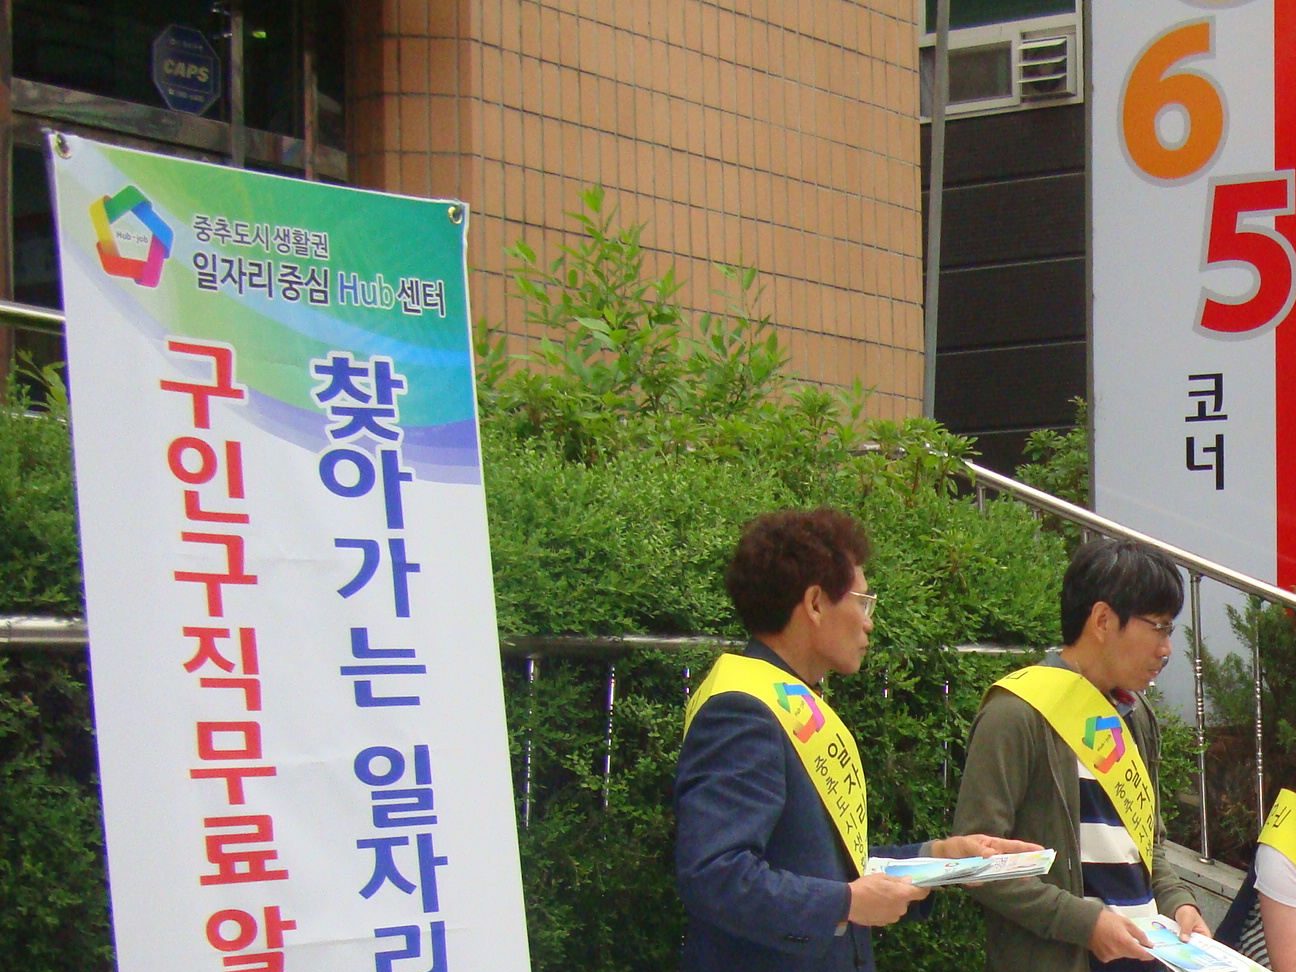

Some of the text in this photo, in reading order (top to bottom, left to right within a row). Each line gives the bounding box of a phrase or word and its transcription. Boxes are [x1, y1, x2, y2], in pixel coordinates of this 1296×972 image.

[164, 59, 209, 82] CAPS
[116, 231, 149, 244] Hub-job
[1185, 373, 1228, 490] 코너
[313, 355, 427, 708] 찾아가는
